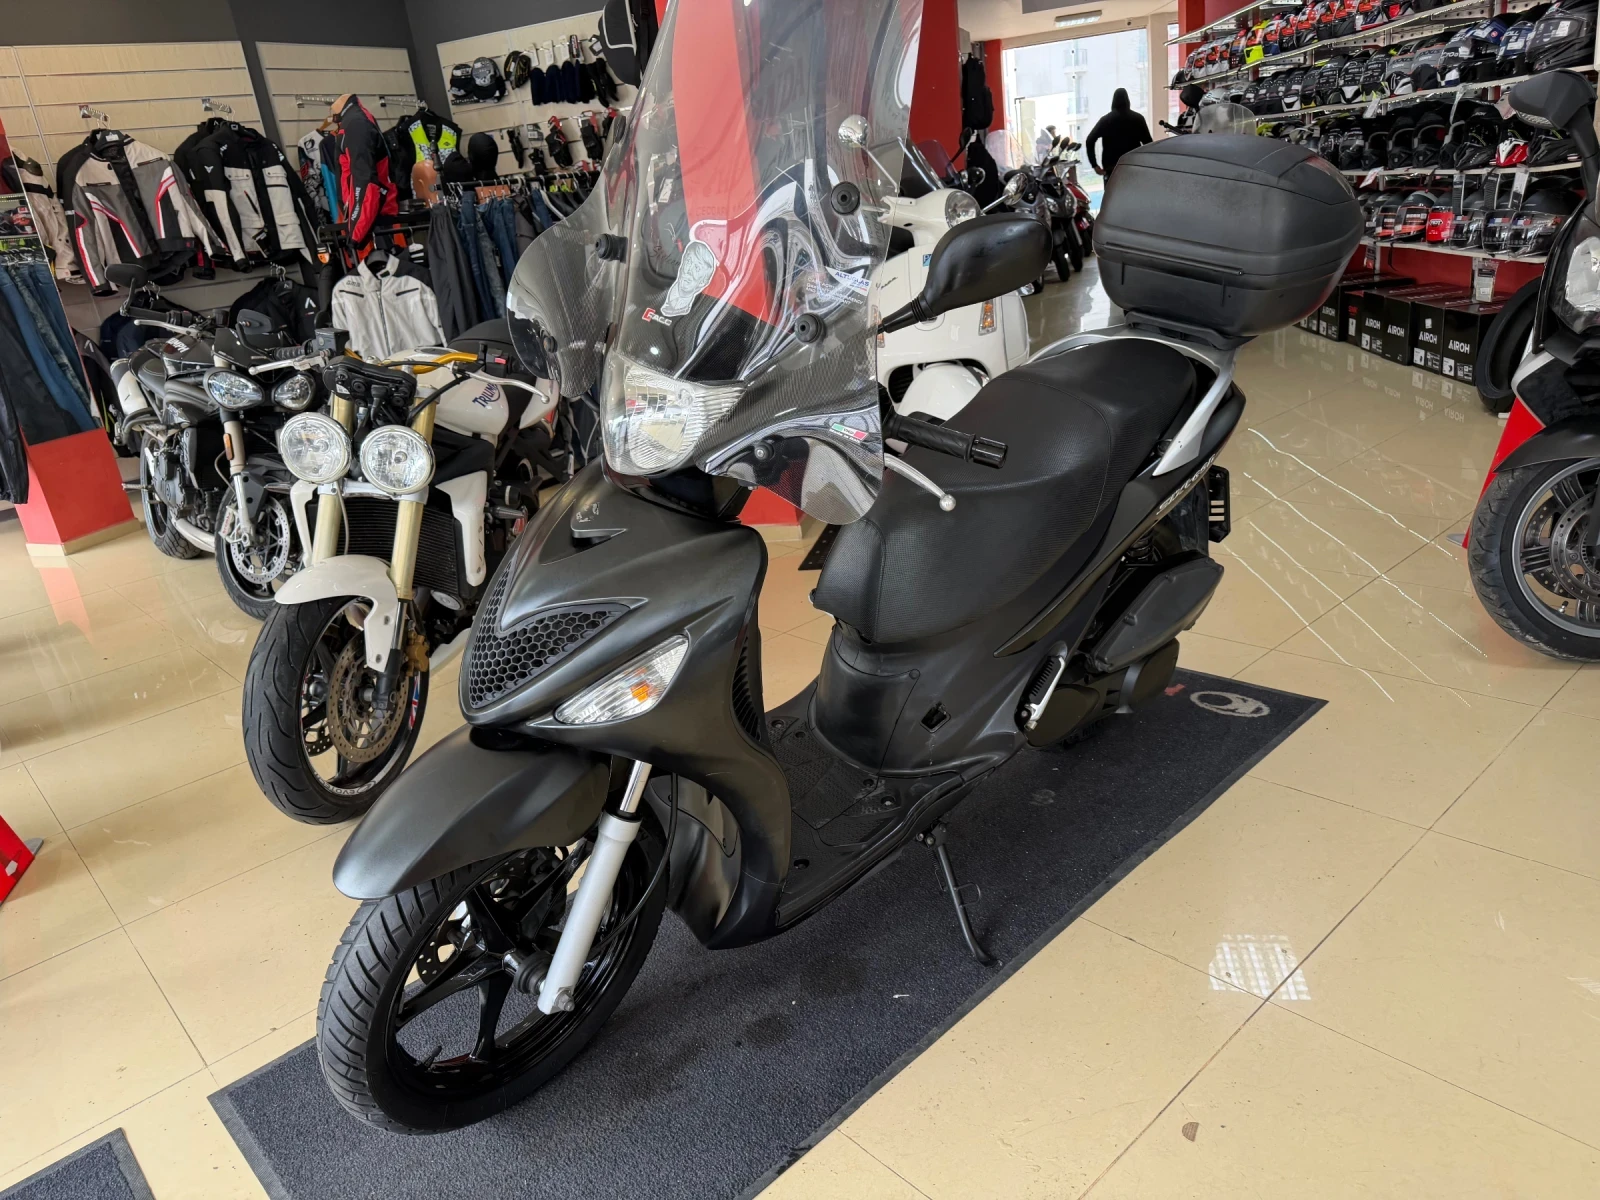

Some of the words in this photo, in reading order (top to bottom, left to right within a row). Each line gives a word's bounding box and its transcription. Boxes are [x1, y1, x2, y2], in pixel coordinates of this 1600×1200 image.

[1365, 317, 1381, 330] AIROH
[1387, 324, 1405, 338] AIROH
[1418, 331, 1438, 345] AIROH
[1448, 339, 1470, 355] AIROH
